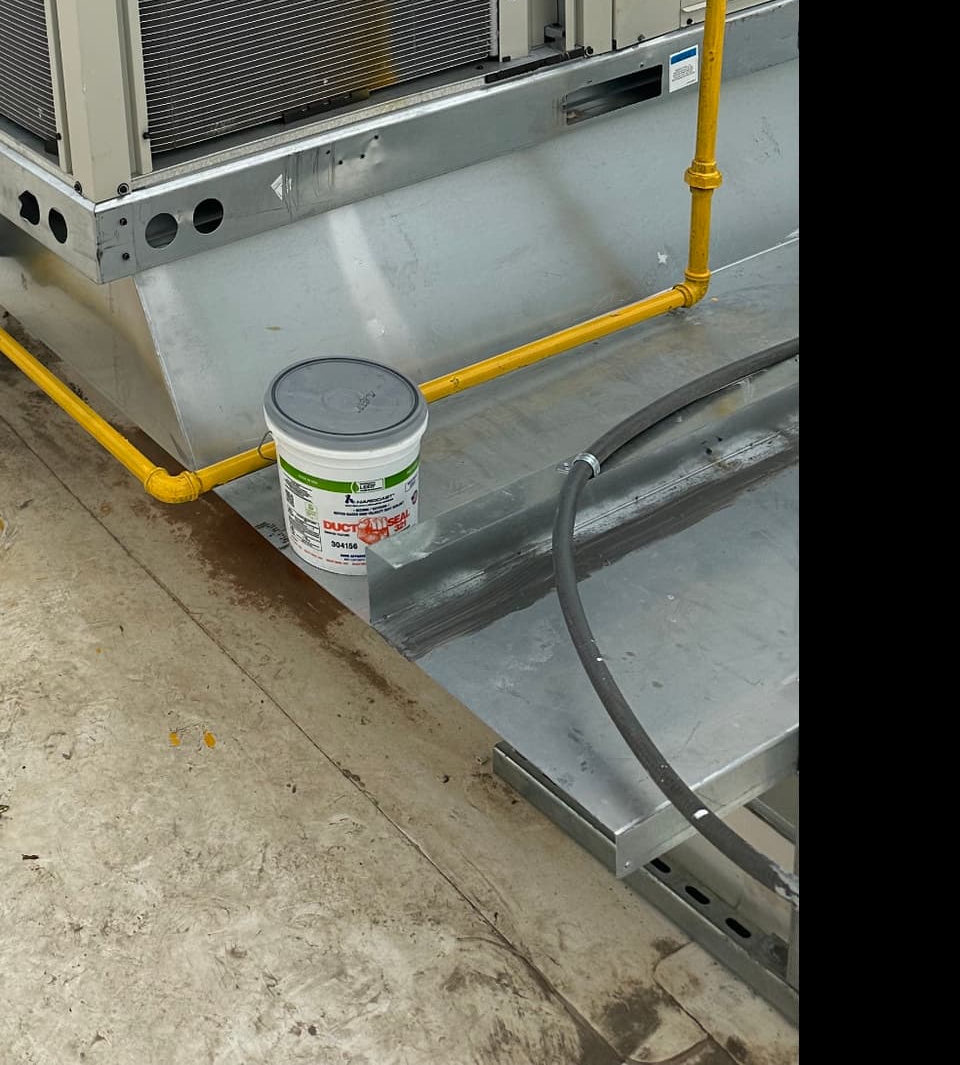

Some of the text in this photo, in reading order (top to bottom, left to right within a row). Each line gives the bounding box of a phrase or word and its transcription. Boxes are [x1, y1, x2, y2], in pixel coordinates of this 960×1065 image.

[323, 509, 410, 533] DUCT SEAL
[331, 540, 358, 550] 304156
